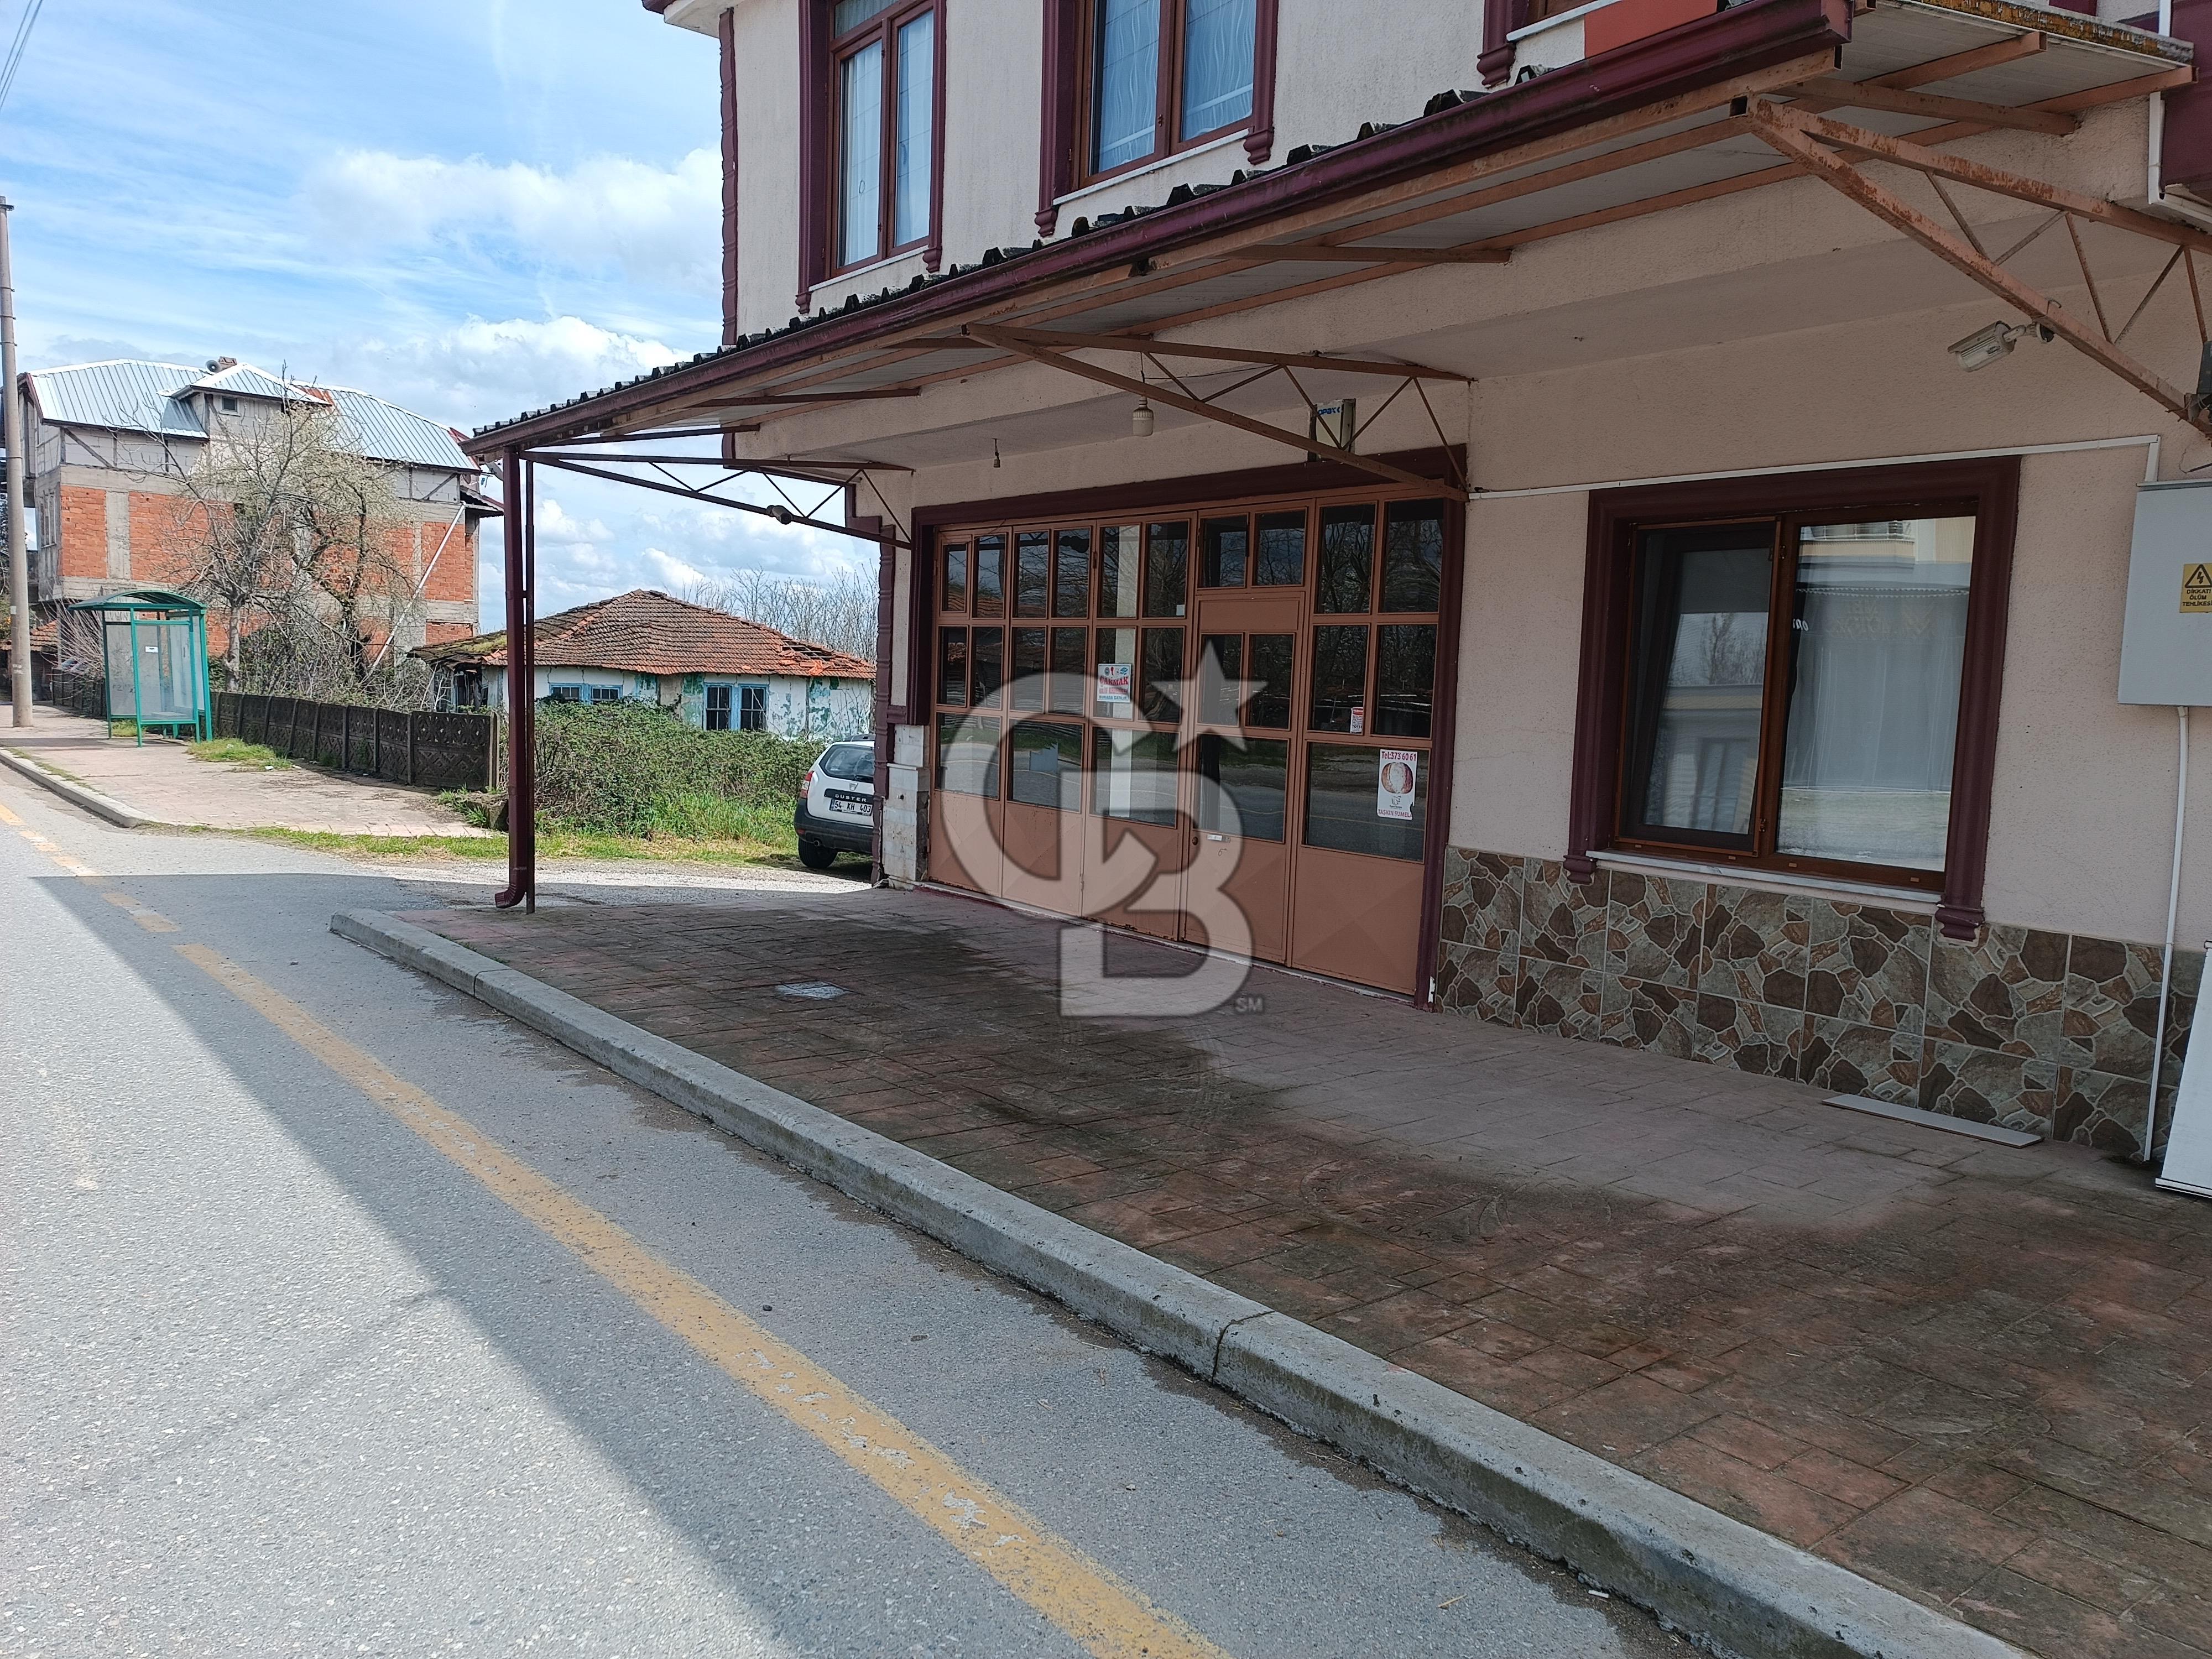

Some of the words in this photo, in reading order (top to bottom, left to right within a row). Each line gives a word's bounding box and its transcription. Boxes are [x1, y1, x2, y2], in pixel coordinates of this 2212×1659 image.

[835, 794, 867, 802] DUSTER
[846, 802, 855, 811] KH
[859, 804, 872, 813] 403
